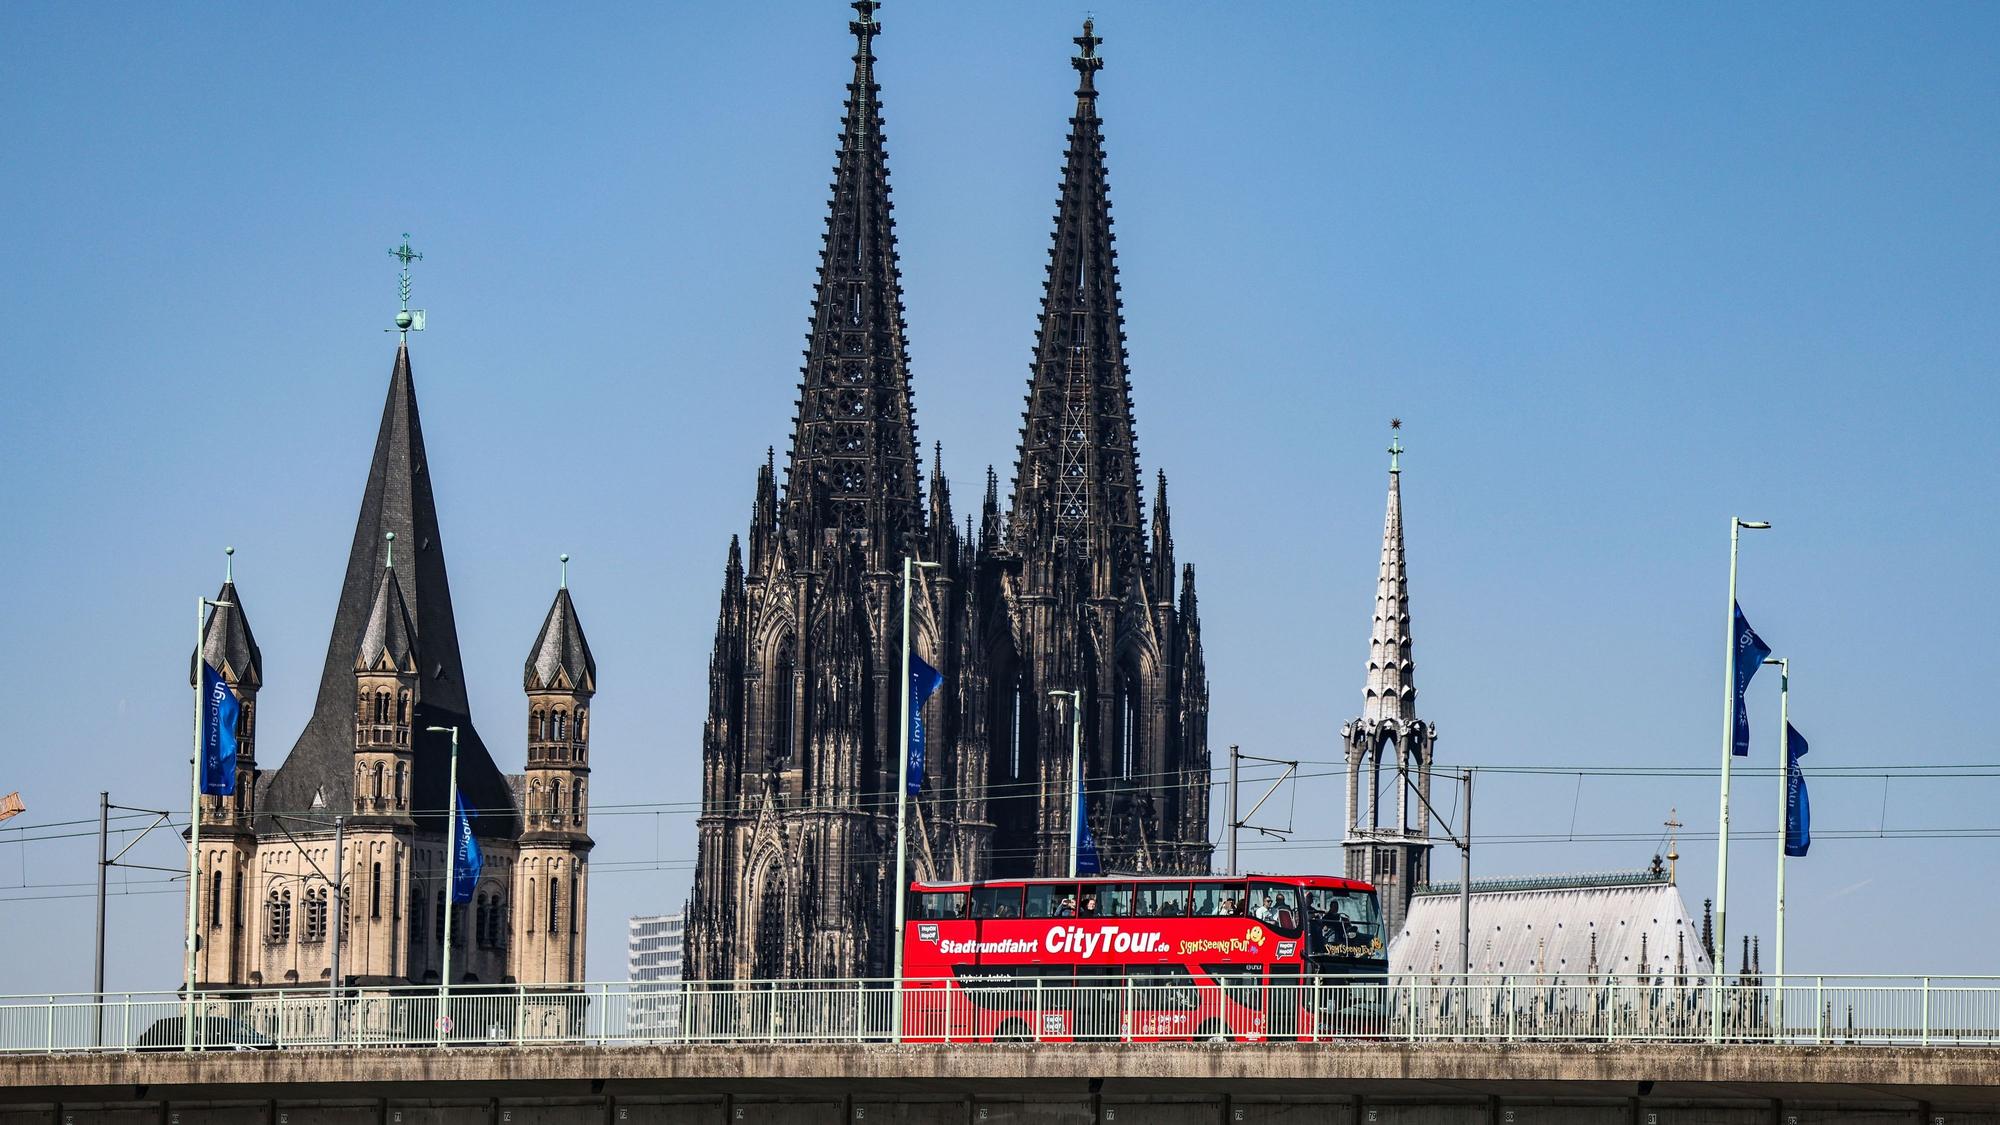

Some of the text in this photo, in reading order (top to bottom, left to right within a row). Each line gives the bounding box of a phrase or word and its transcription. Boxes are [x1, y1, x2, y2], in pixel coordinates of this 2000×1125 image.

[210, 682, 226, 747] invisalign
[940, 926, 1170, 959] Stadtrundfahrt CityTour.de
[1648, 1114, 1656, 1124] 81
